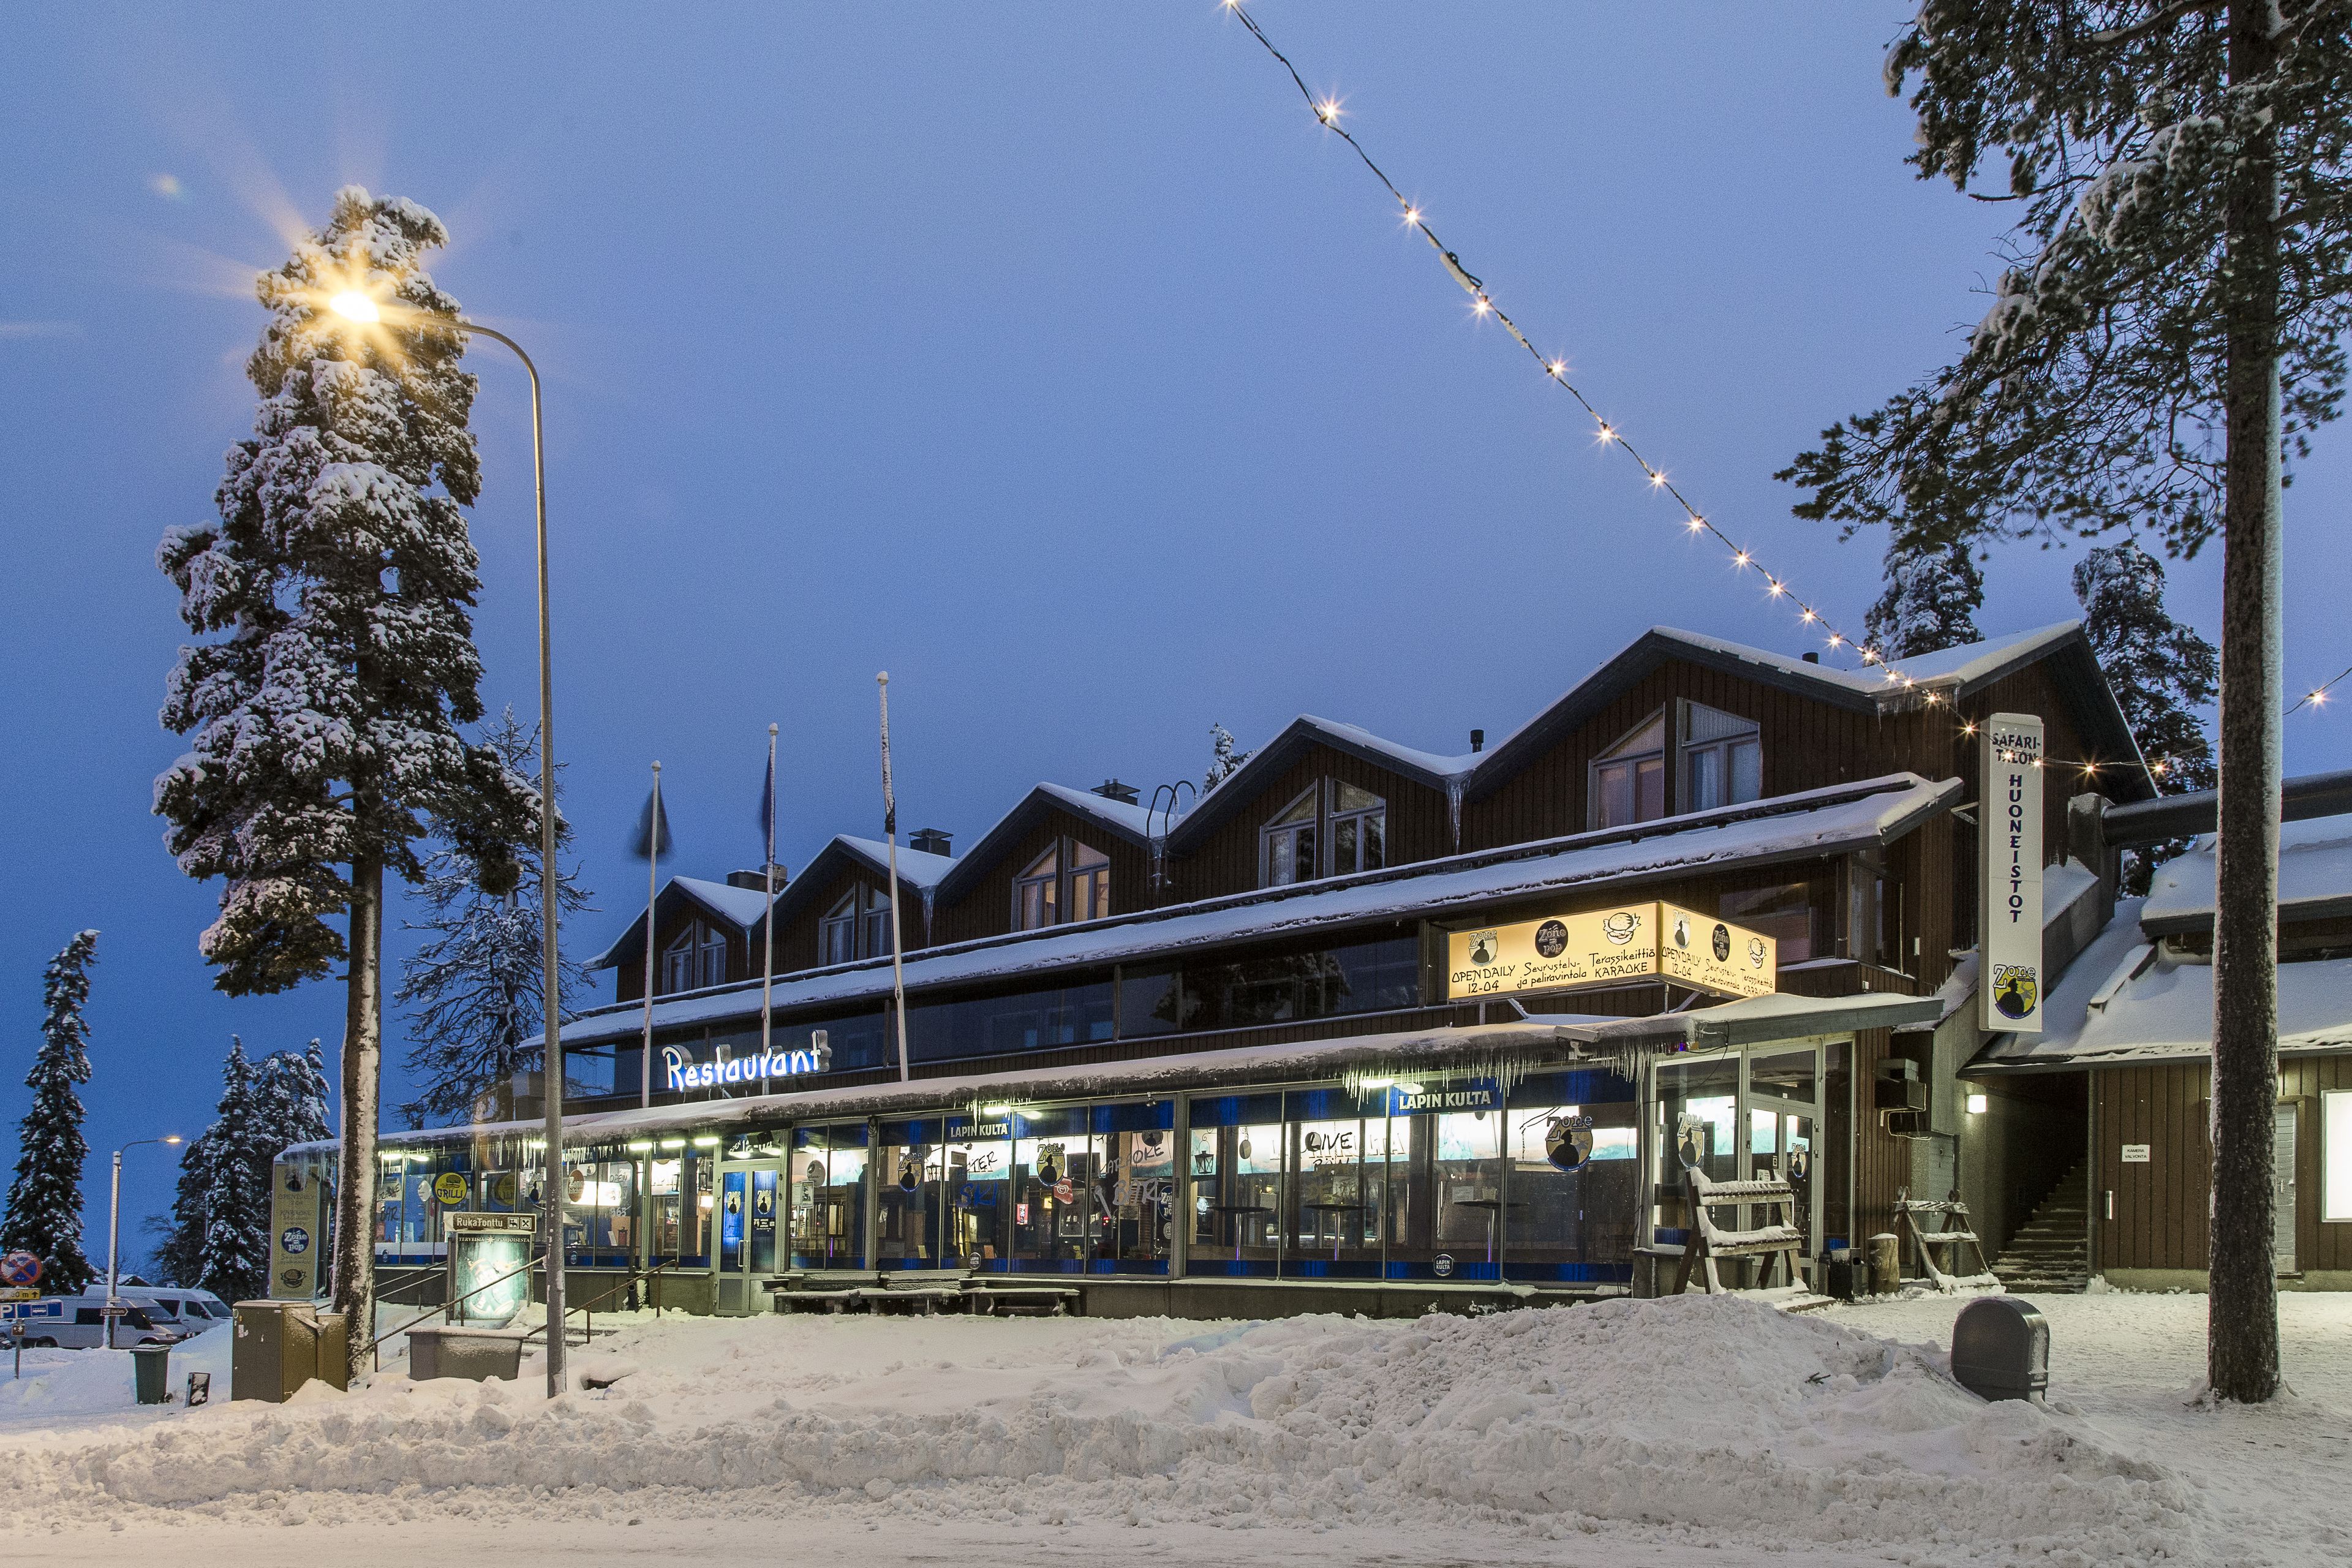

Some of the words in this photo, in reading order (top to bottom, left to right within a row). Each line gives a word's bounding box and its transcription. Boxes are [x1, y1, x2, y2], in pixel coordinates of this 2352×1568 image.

[1992, 733, 2040, 749] SAFARI-
[2008, 774, 2022, 923] HUONEISTOT
[1468, 930, 1498, 949] Zone
[1544, 944, 1562, 955] pop
[1589, 948, 1656, 967] Terassikeittiö
[1662, 946, 1681, 962] OPEN
[1681, 951, 1701, 967] DAILY
[1716, 948, 1727, 959] pop
[1452, 969, 1481, 982] OPEN
[1483, 965, 1515, 979] DAILY
[1524, 957, 1580, 976] Seurustelu-
[1595, 962, 1648, 978] KARAOKE
[1672, 963, 1692, 979] 12-04
[1705, 959, 1736, 977] Seurustelu-
[1517, 978, 1527, 989] ja
[1531, 967, 1586, 987] peliravintola
[1709, 975, 1740, 990] peliravintola
[1740, 968, 1773, 988] Terassikeittiö
[1993, 964, 2036, 989] Zone
[1468, 980, 1499, 993] 12-04
[662, 1030, 822, 1093] Restaurant
[1399, 1093, 1442, 1110] LAPIN
[1446, 1090, 1491, 1107] KULTA
[951, 1125, 977, 1138] LAPIN
[979, 1123, 1008, 1136] KULTA
[1545, 1115, 1593, 1142] Zone
[1678, 1111, 1703, 1138] Zone
[1309, 1131, 1352, 1152] LIVE
[898, 1152, 922, 1171] Zone
[1037, 1143, 1066, 1164] Zone
[437, 1188, 463, 1199] GRILLI
[957, 1182, 999, 1208] SKI
[1113, 1178, 1161, 1205] BAR
[456, 1217, 503, 1227] RukaTonttu
[0, 1305, 13, 1319] P
